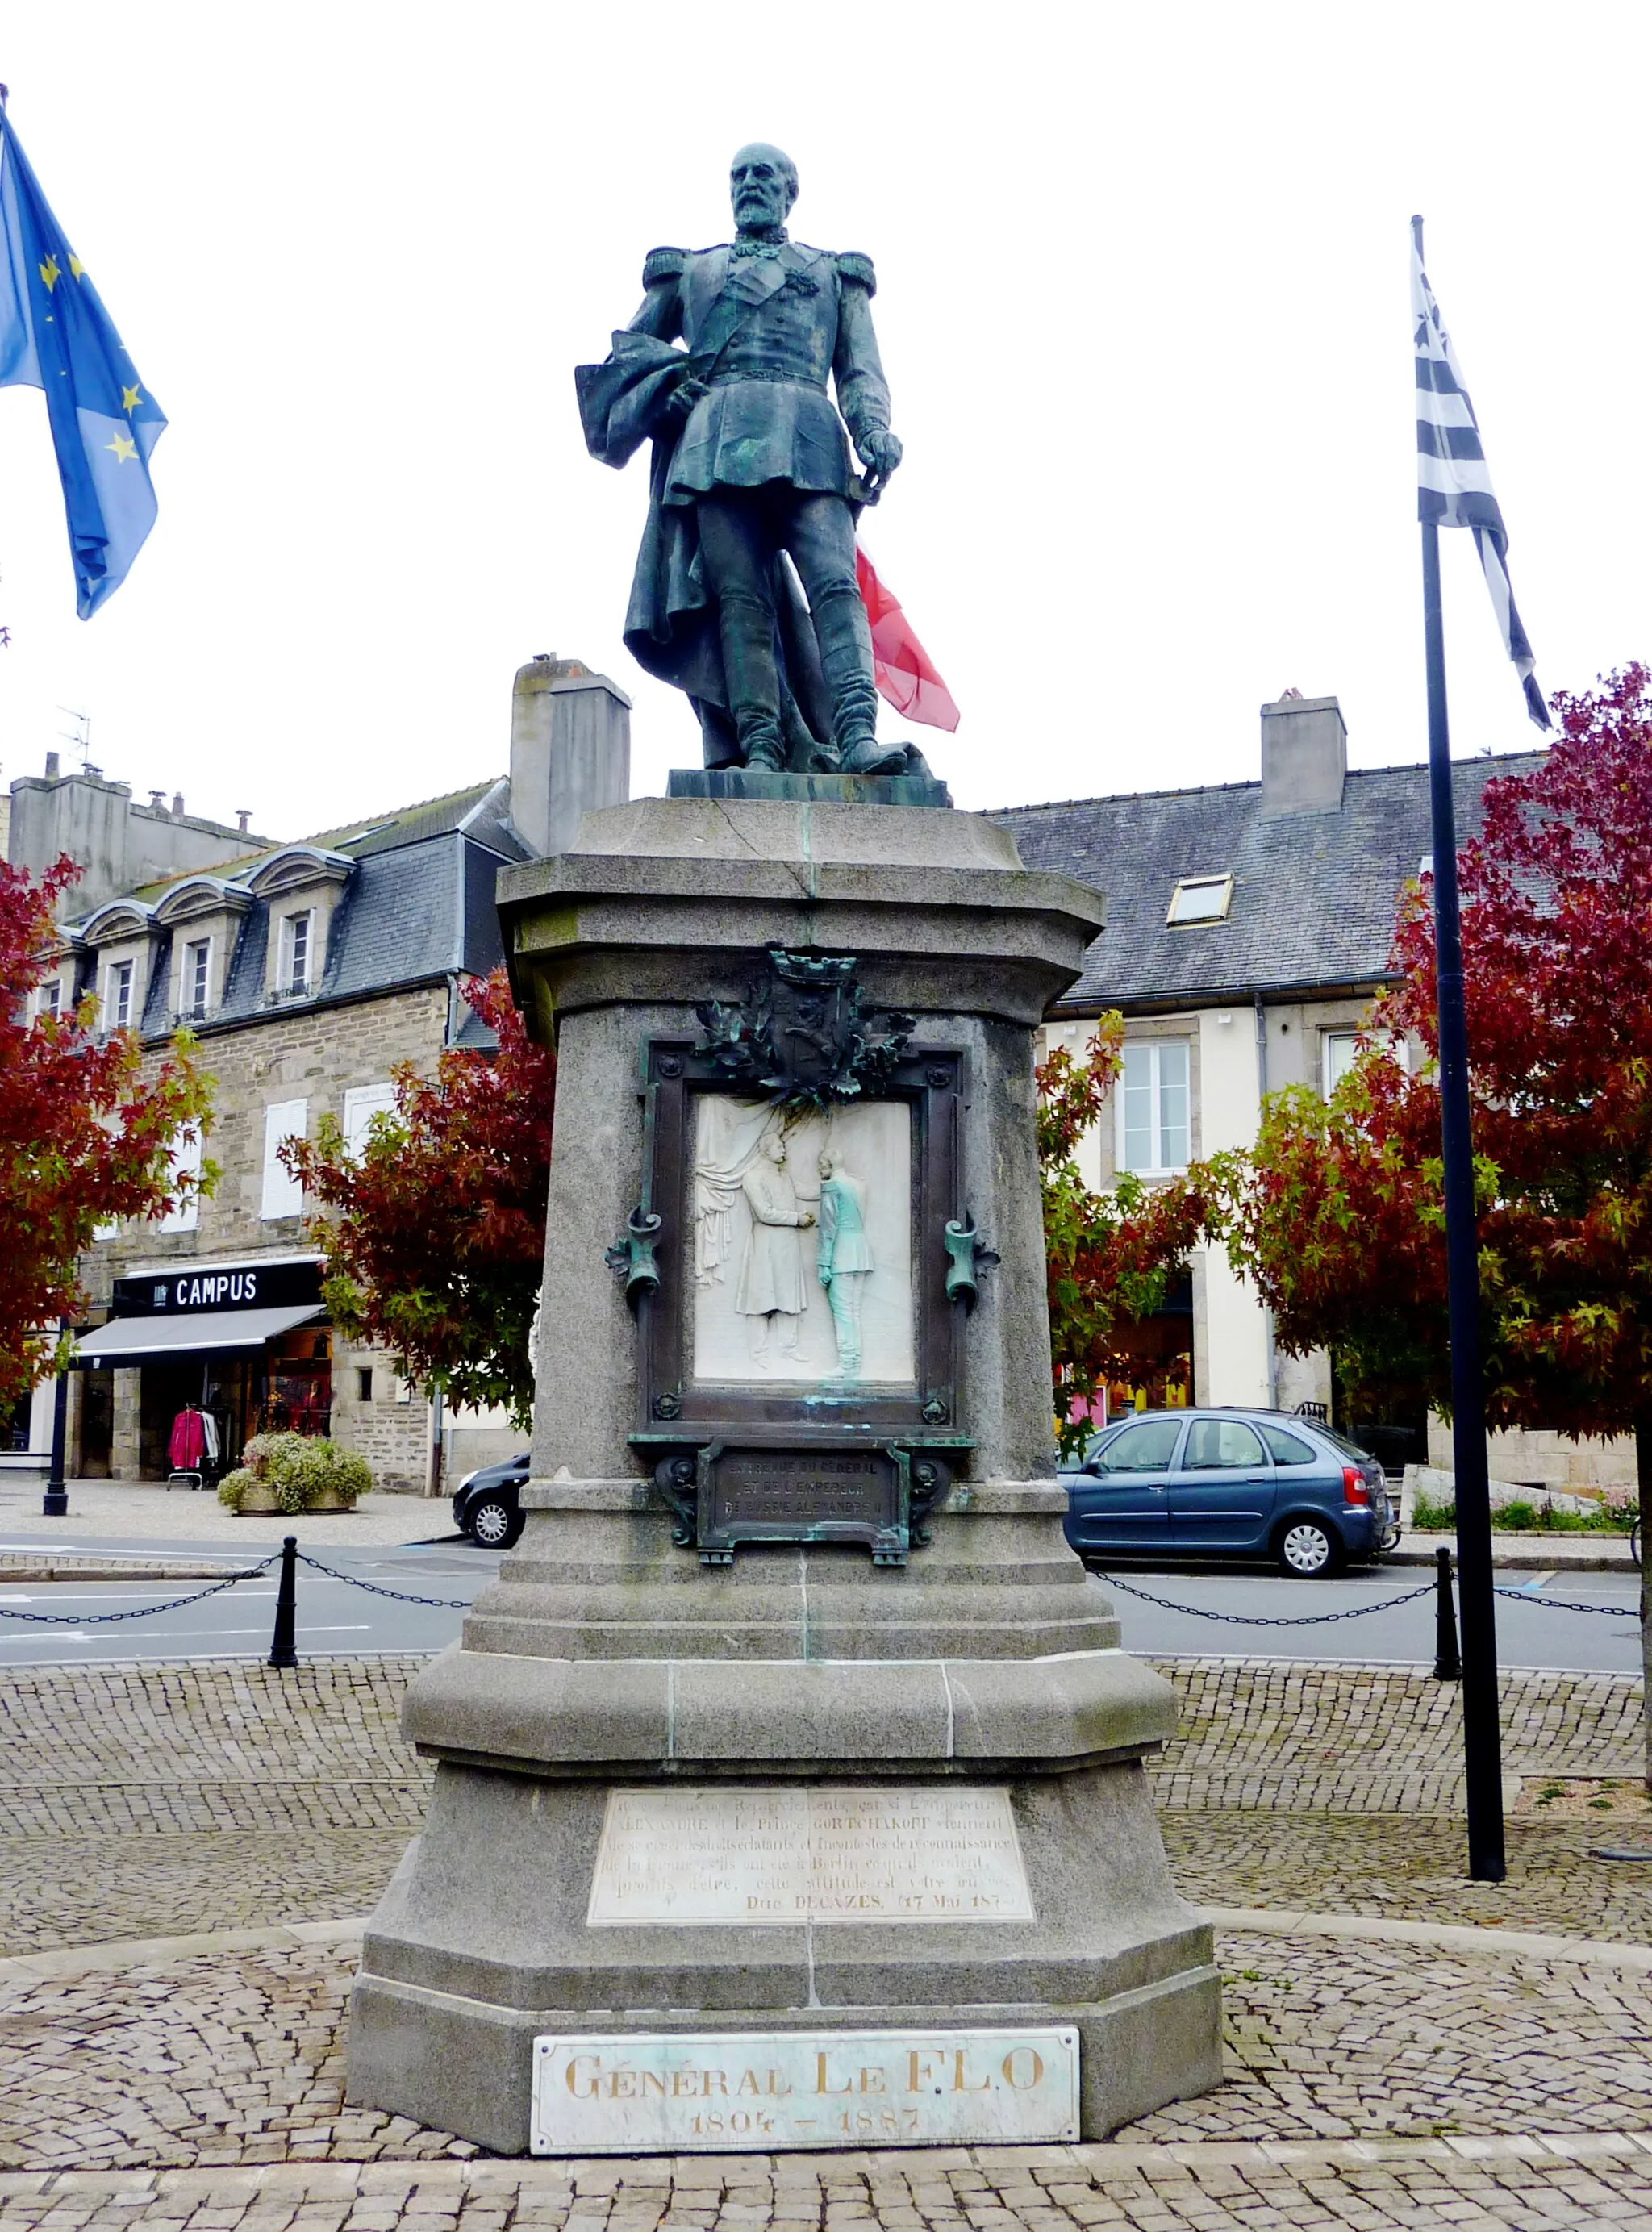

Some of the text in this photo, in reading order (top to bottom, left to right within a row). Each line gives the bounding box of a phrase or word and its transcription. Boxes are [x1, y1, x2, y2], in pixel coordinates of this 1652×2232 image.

[177, 1273, 257, 1305] CAMPUS
[743, 1480, 759, 1494] ET
[763, 1480, 781, 1494] DE
[758, 1816, 804, 1831] Prince
[932, 1894, 961, 1909] Mai
[565, 2054, 795, 2100] GÉNÉRAL
[690, 2107, 775, 2134] 1804
[838, 2107, 920, 2134] 1887
